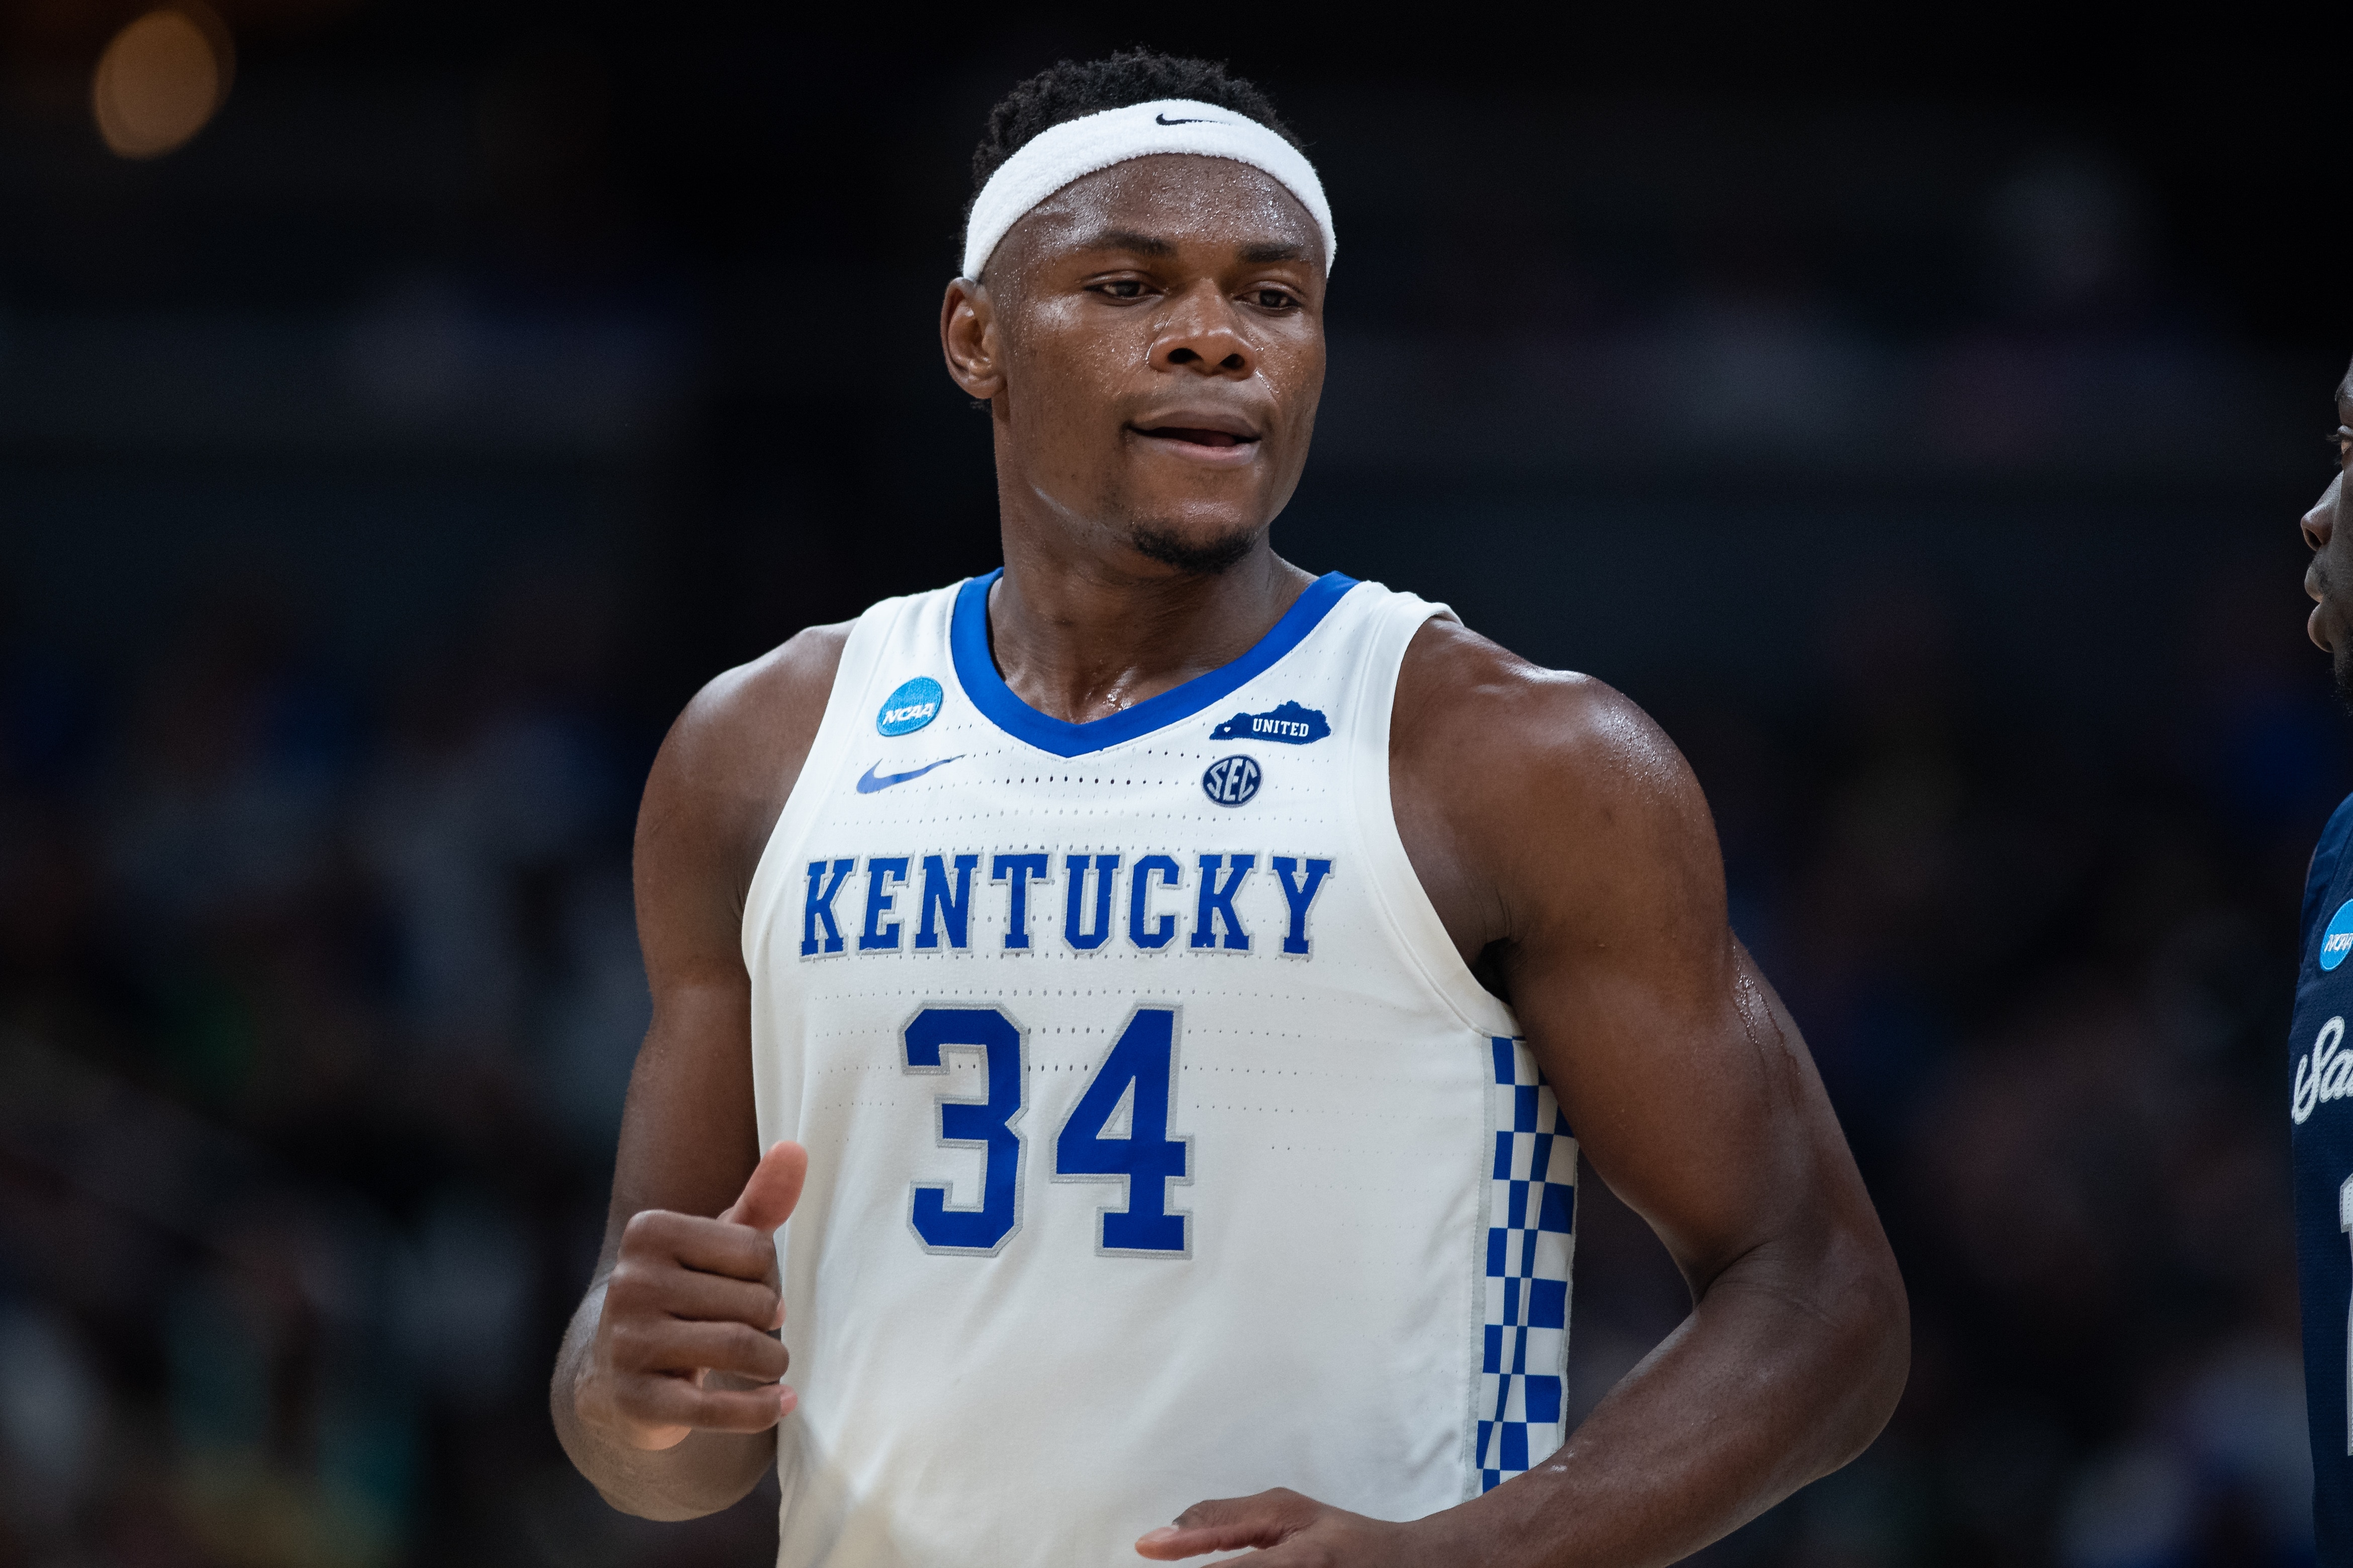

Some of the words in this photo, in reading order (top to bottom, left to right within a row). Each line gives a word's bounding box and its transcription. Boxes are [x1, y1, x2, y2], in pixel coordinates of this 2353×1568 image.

[882, 703, 935, 725] NCAA
[1253, 718, 1309, 737] UNITED
[1207, 758, 1257, 801] SEC
[800, 853, 1334, 961] KENTUCKY
[898, 1000, 1195, 1260] 34
